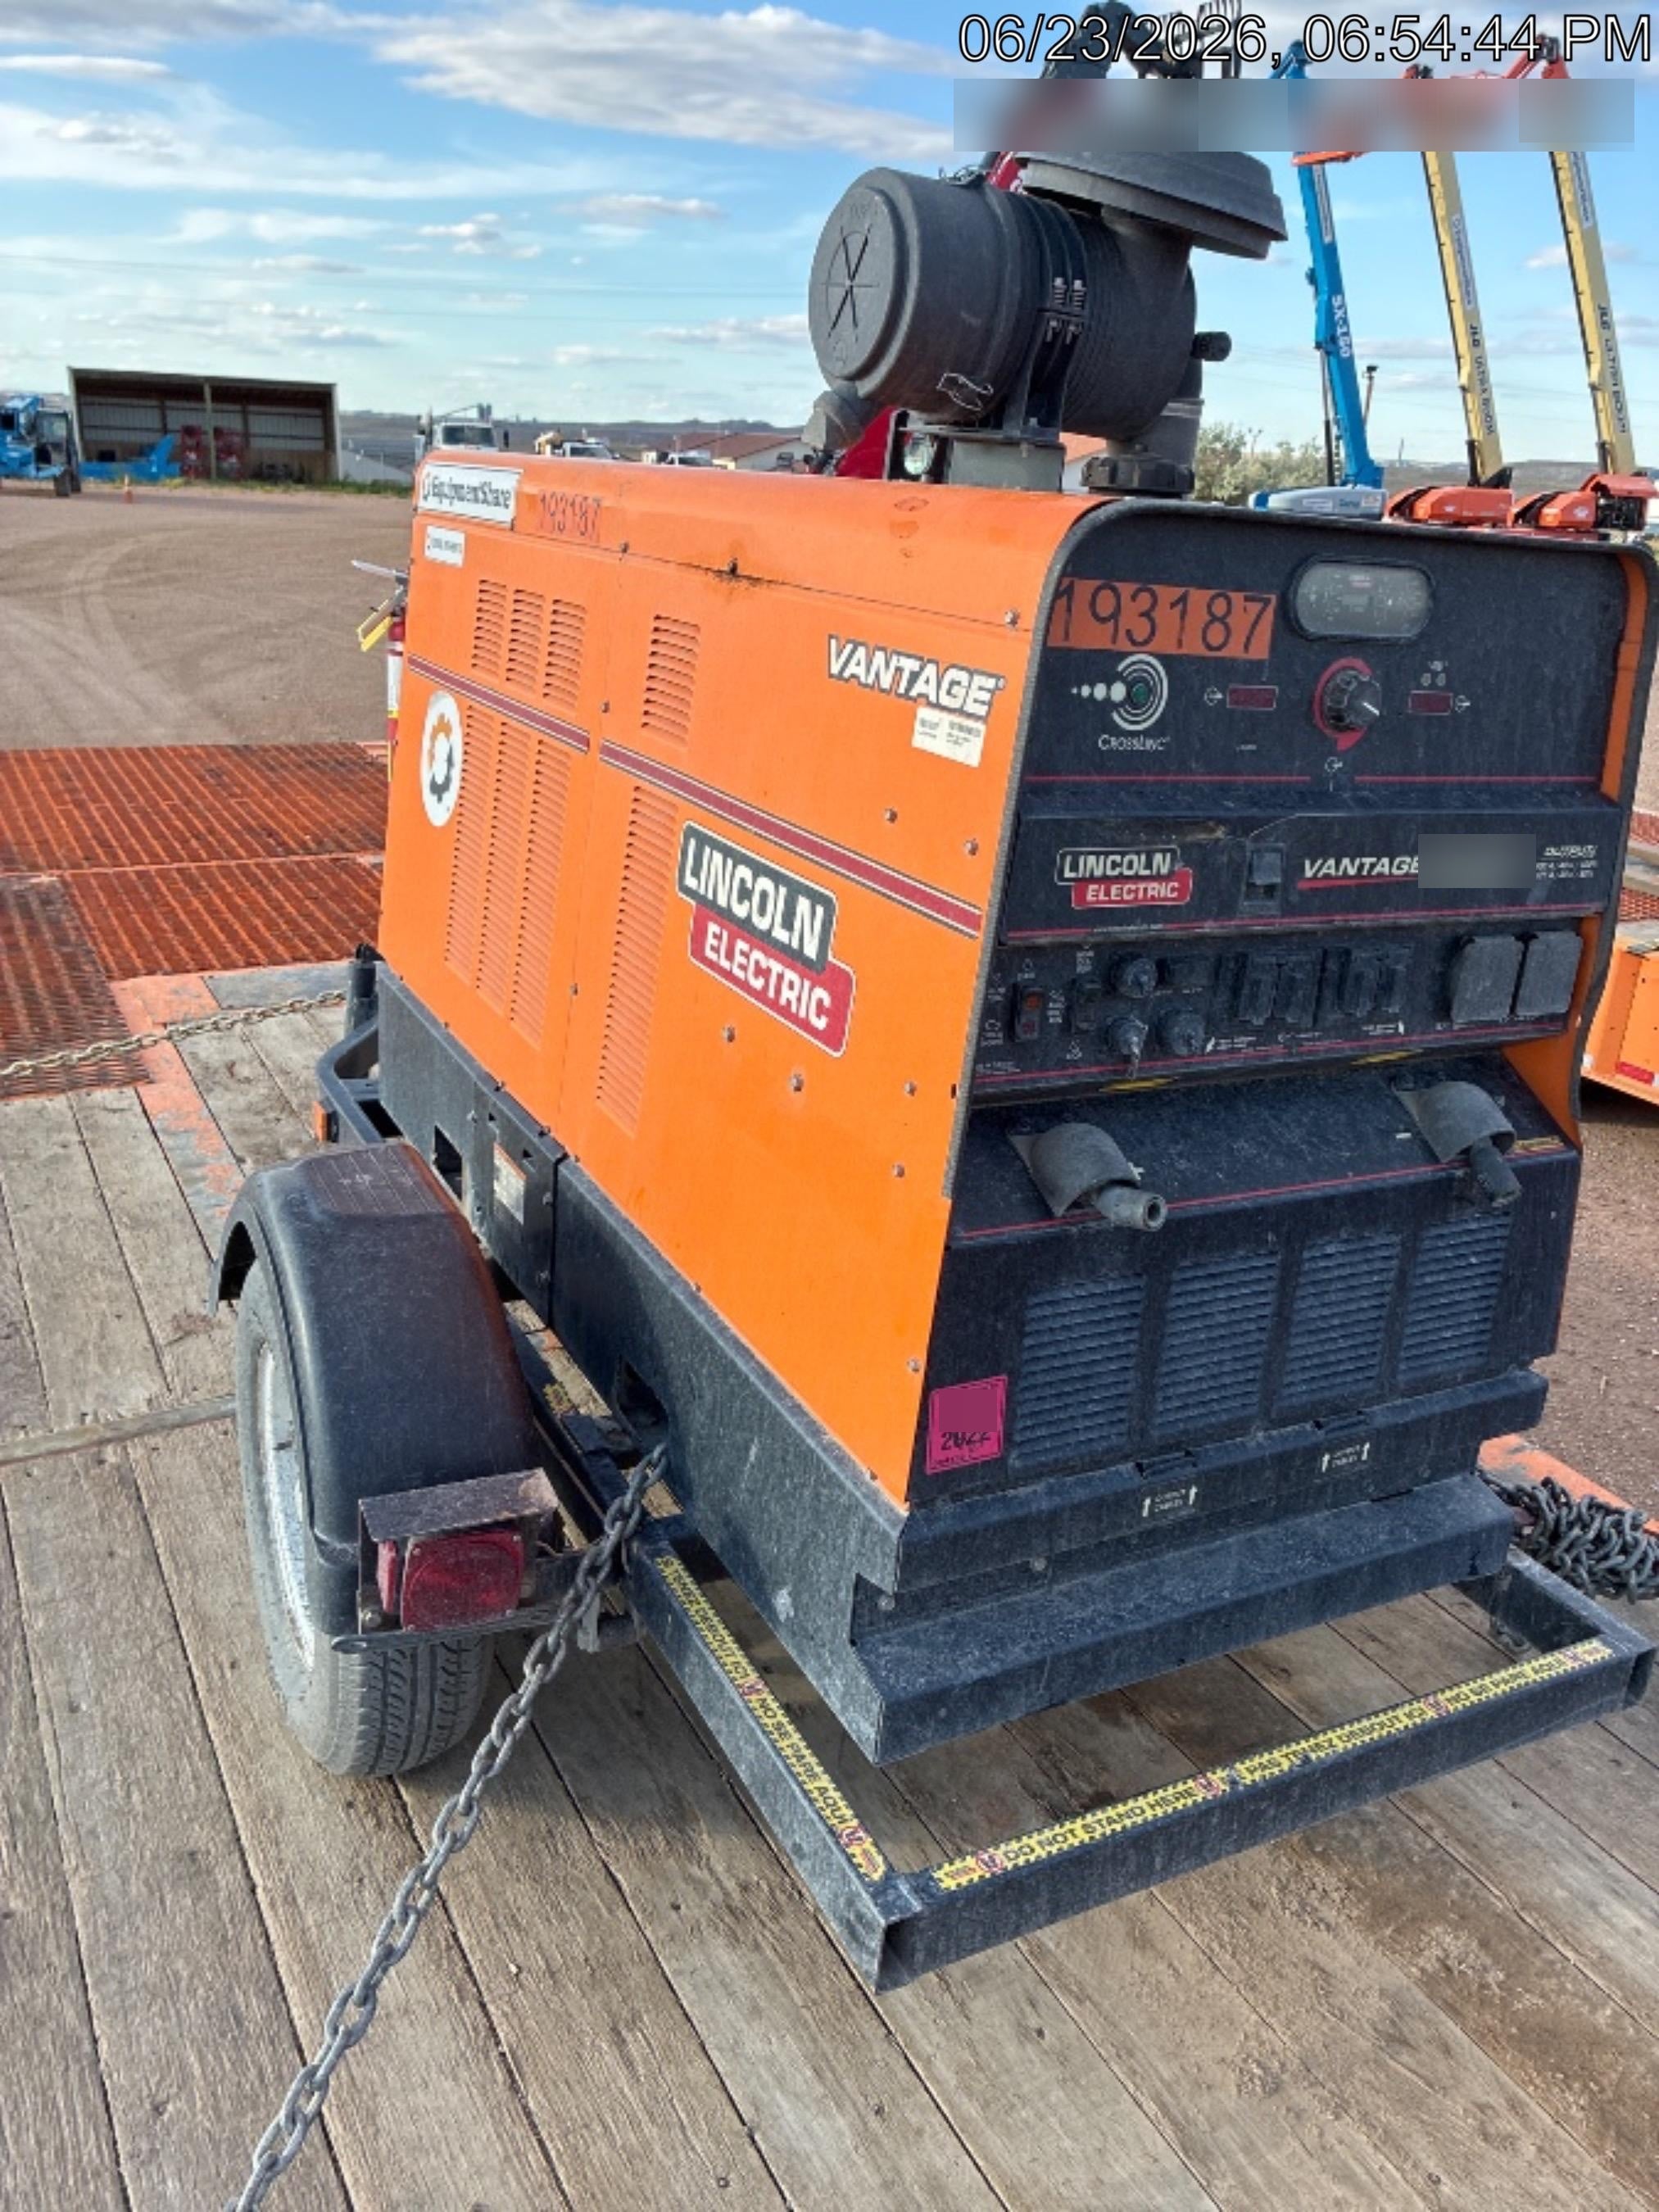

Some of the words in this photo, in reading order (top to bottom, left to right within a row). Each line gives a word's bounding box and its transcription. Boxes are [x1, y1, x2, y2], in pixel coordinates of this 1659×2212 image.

[1052, 580, 1272, 654] 193187
[827, 635, 1001, 722] VANTAGE
[683, 836, 825, 962] LINCOLN
[1063, 852, 1172, 878] LINCOLN
[1086, 882, 1180, 903] ELECTRIC
[705, 921, 832, 1031] ELECTRIC
[786, 1742, 821, 1782] PARE
[1005, 1844, 1036, 1862] DO
[1039, 1829, 1078, 1850] NOT
[1081, 1806, 1147, 1835] STAND
[1145, 1786, 1197, 1815] HERE
